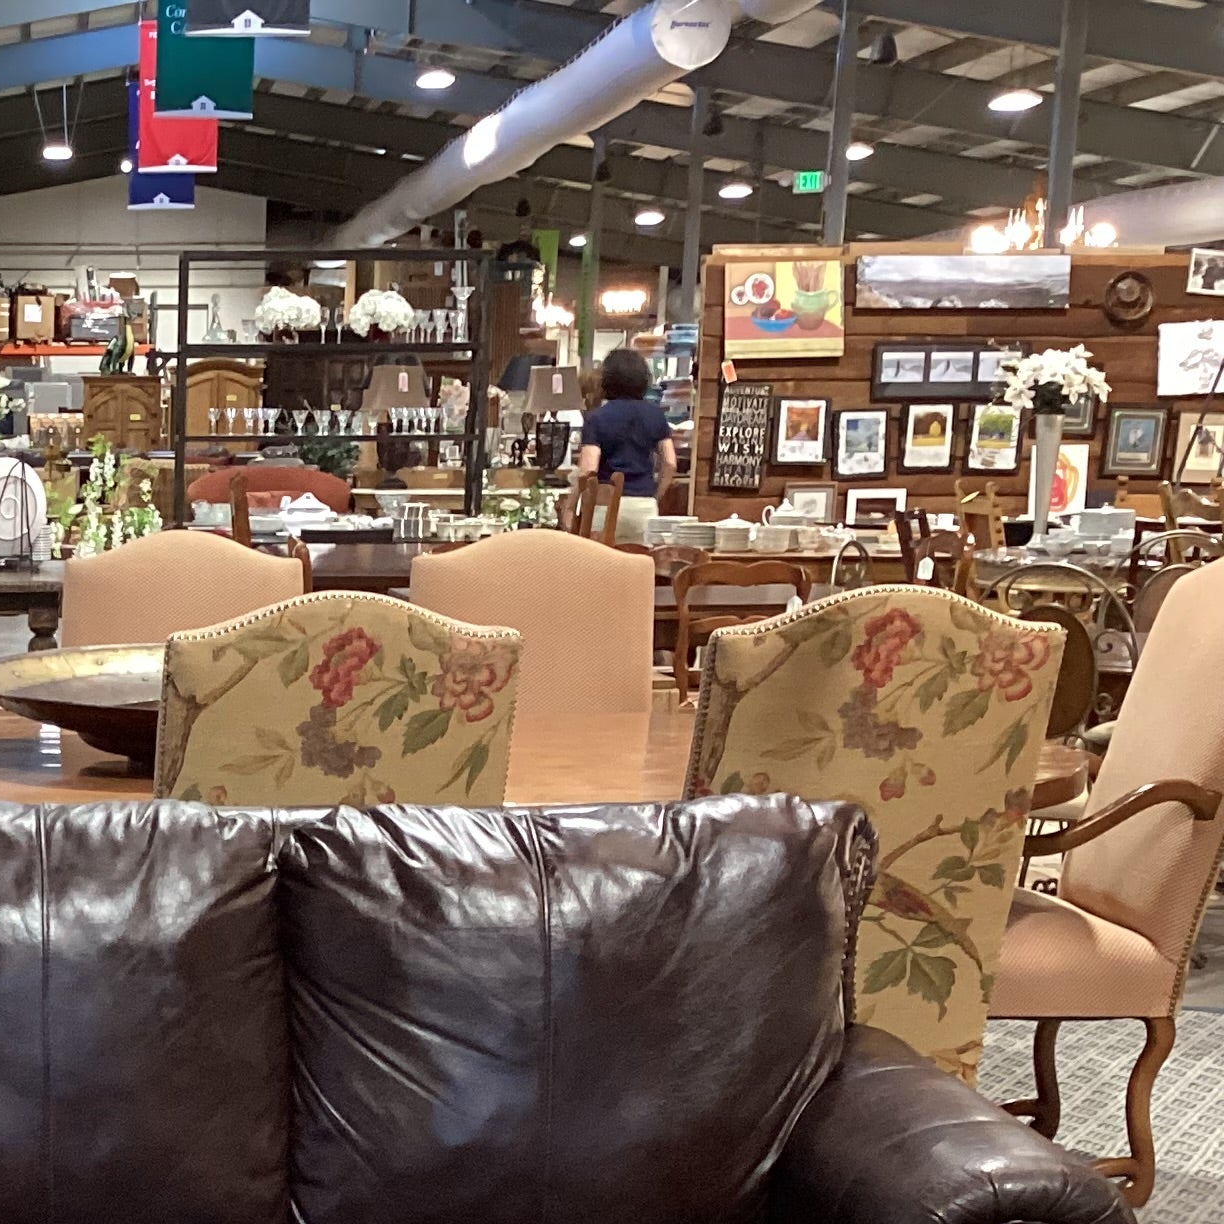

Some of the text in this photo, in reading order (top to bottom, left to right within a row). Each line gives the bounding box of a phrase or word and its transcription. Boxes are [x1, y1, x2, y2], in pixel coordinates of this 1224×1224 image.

[799, 172, 821, 190] EXIT
[722, 396, 768, 409] MOTIVATE
[719, 426, 766, 438] EXPLORE
[718, 443, 764, 454] WISH
[716, 454, 763, 466] HARMONY
